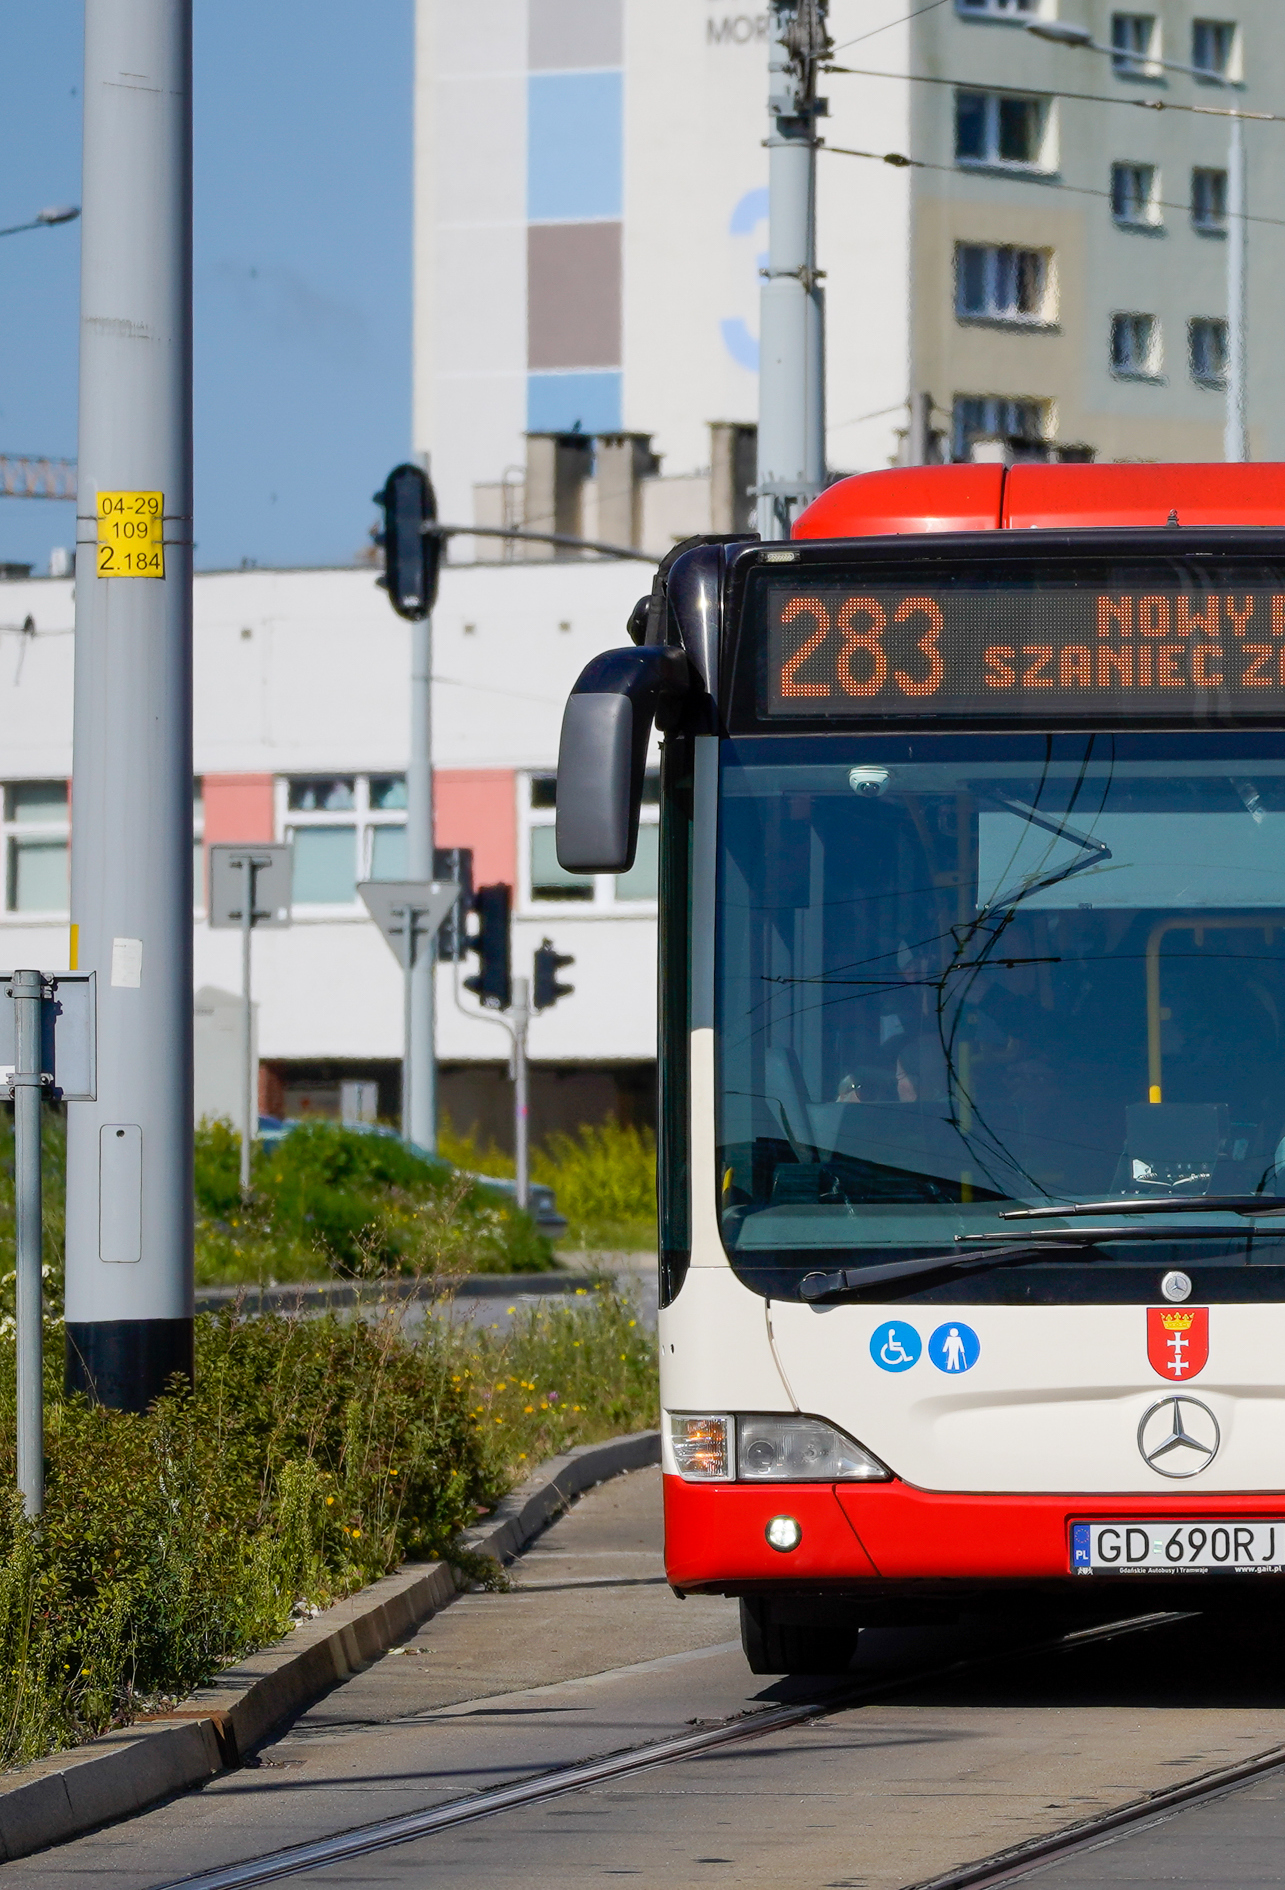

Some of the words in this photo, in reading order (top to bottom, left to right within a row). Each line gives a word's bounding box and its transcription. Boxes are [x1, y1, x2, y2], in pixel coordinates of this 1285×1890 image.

[102, 497, 159, 515] 04-29
[112, 521, 148, 539] 109
[100, 545, 160, 570] 2.184
[1097, 595, 1254, 637] NOWY
[780, 597, 944, 696] 283
[984, 645, 1224, 687] SZANIEC
[1075, 1549, 1089, 1561] PL
[1097, 1528, 1150, 1563] GD
[1165, 1527, 1275, 1562] 690RJ
[1147, 1567, 1176, 1575] Autobusy
[1180, 1567, 1209, 1575] Tramwaje
[1234, 1564, 1283, 1574] www.gait.pl
